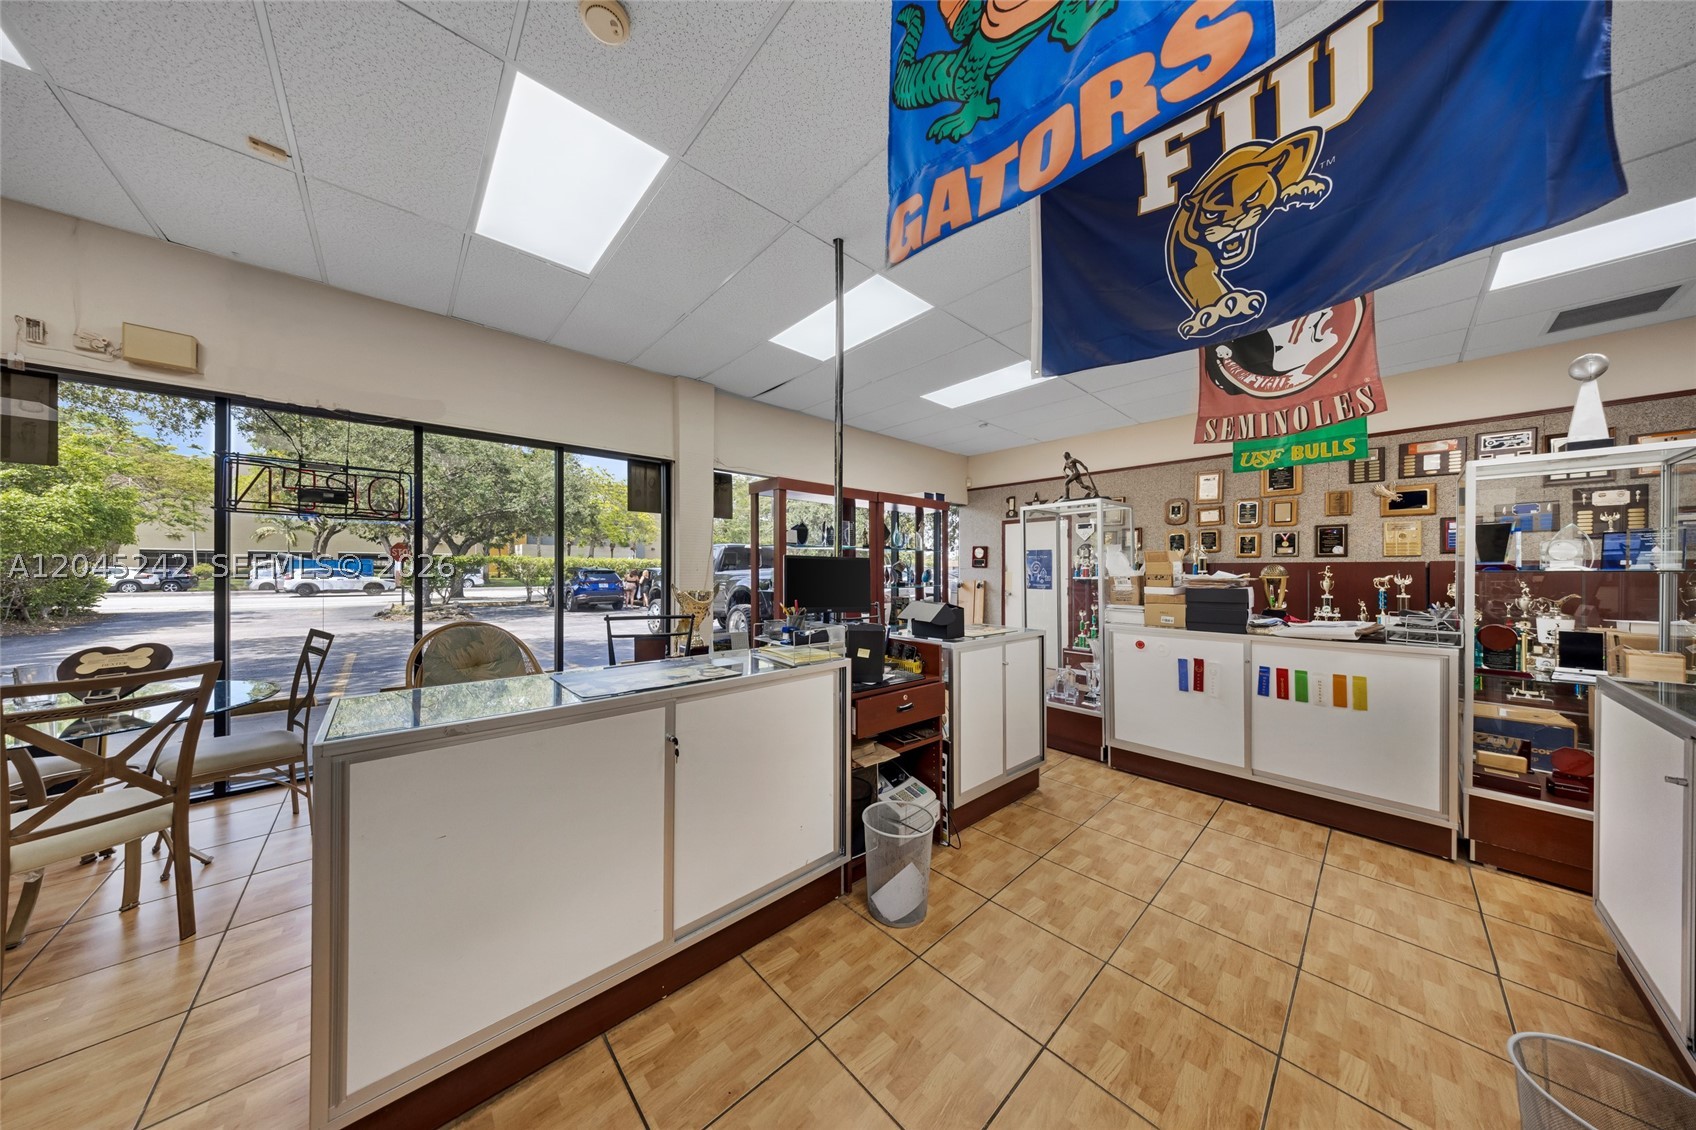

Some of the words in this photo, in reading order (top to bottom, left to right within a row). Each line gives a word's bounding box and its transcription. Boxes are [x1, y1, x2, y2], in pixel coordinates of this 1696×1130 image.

[888, 0, 1256, 265] GATORS
[1136, 0, 1386, 217] FIU
[1203, 386, 1376, 442] SEMINOLES
[1240, 447, 1285, 468] USF
[1291, 437, 1357, 462] BULLS
